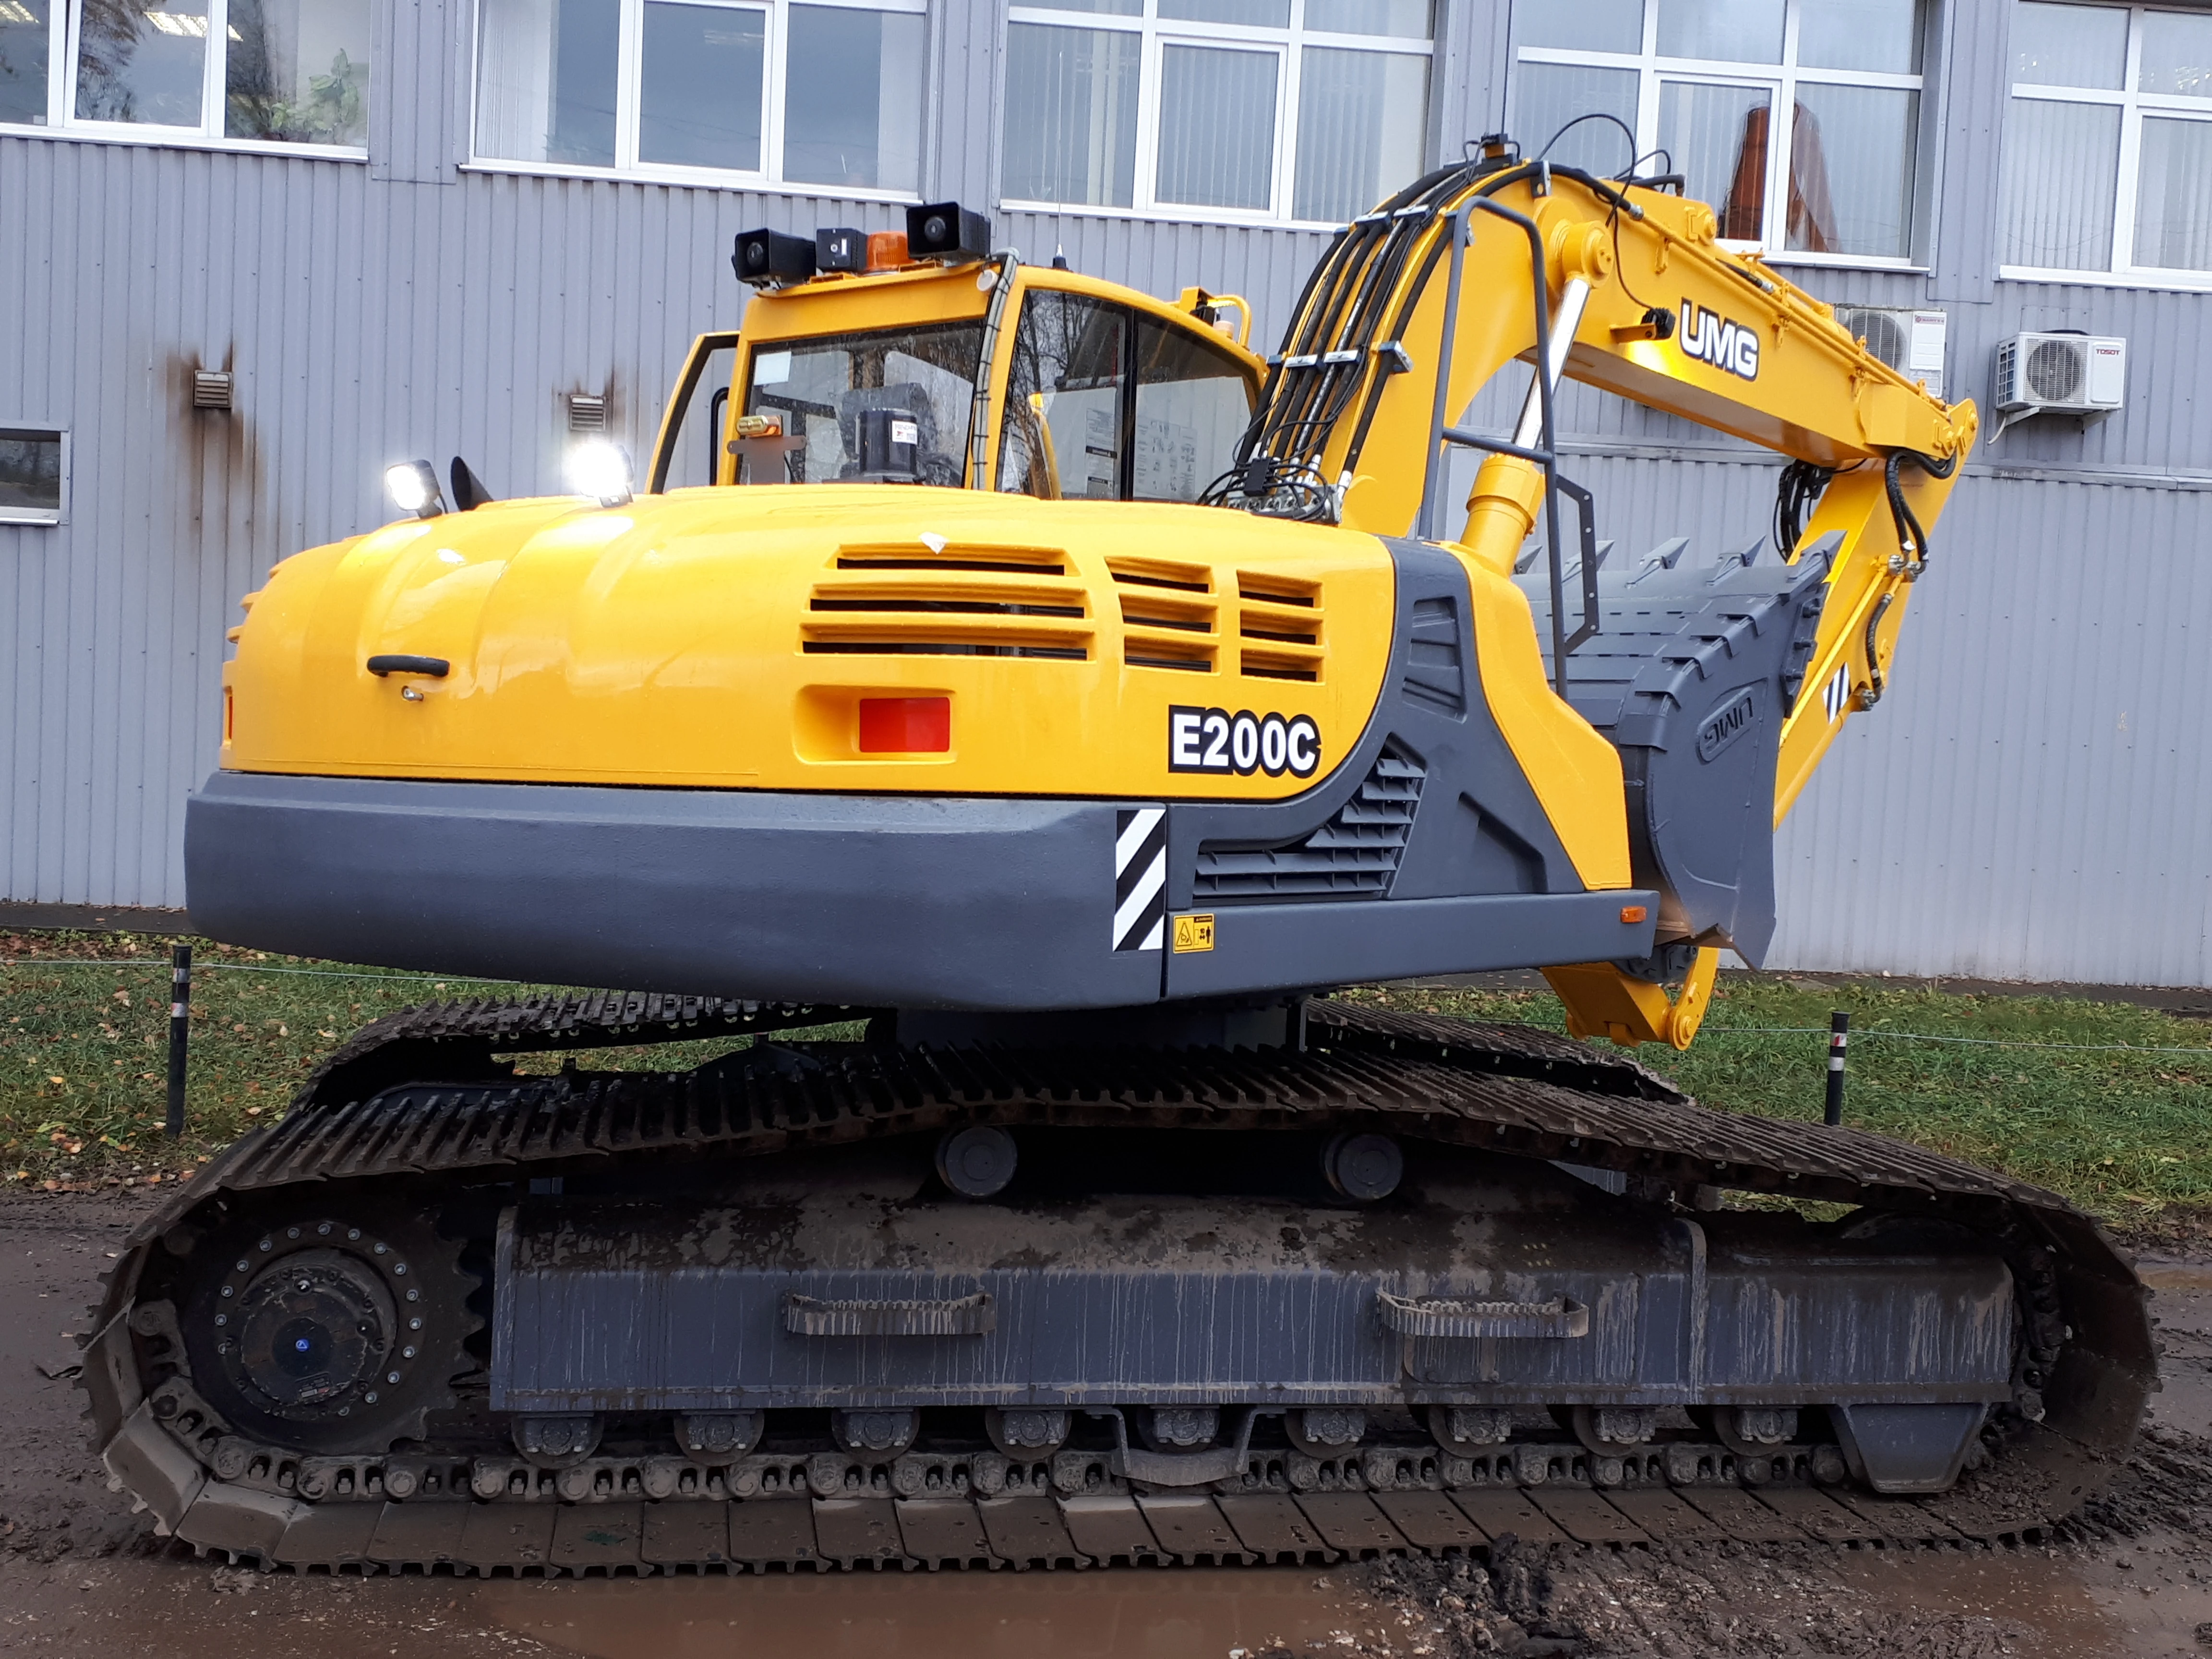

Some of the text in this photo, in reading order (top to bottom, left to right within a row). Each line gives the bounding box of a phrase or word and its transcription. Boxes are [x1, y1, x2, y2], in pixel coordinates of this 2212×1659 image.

[1680, 300, 1758, 379] UMG
[1171, 710, 1318, 773] E200C
[1704, 697, 1754, 751] UMG
